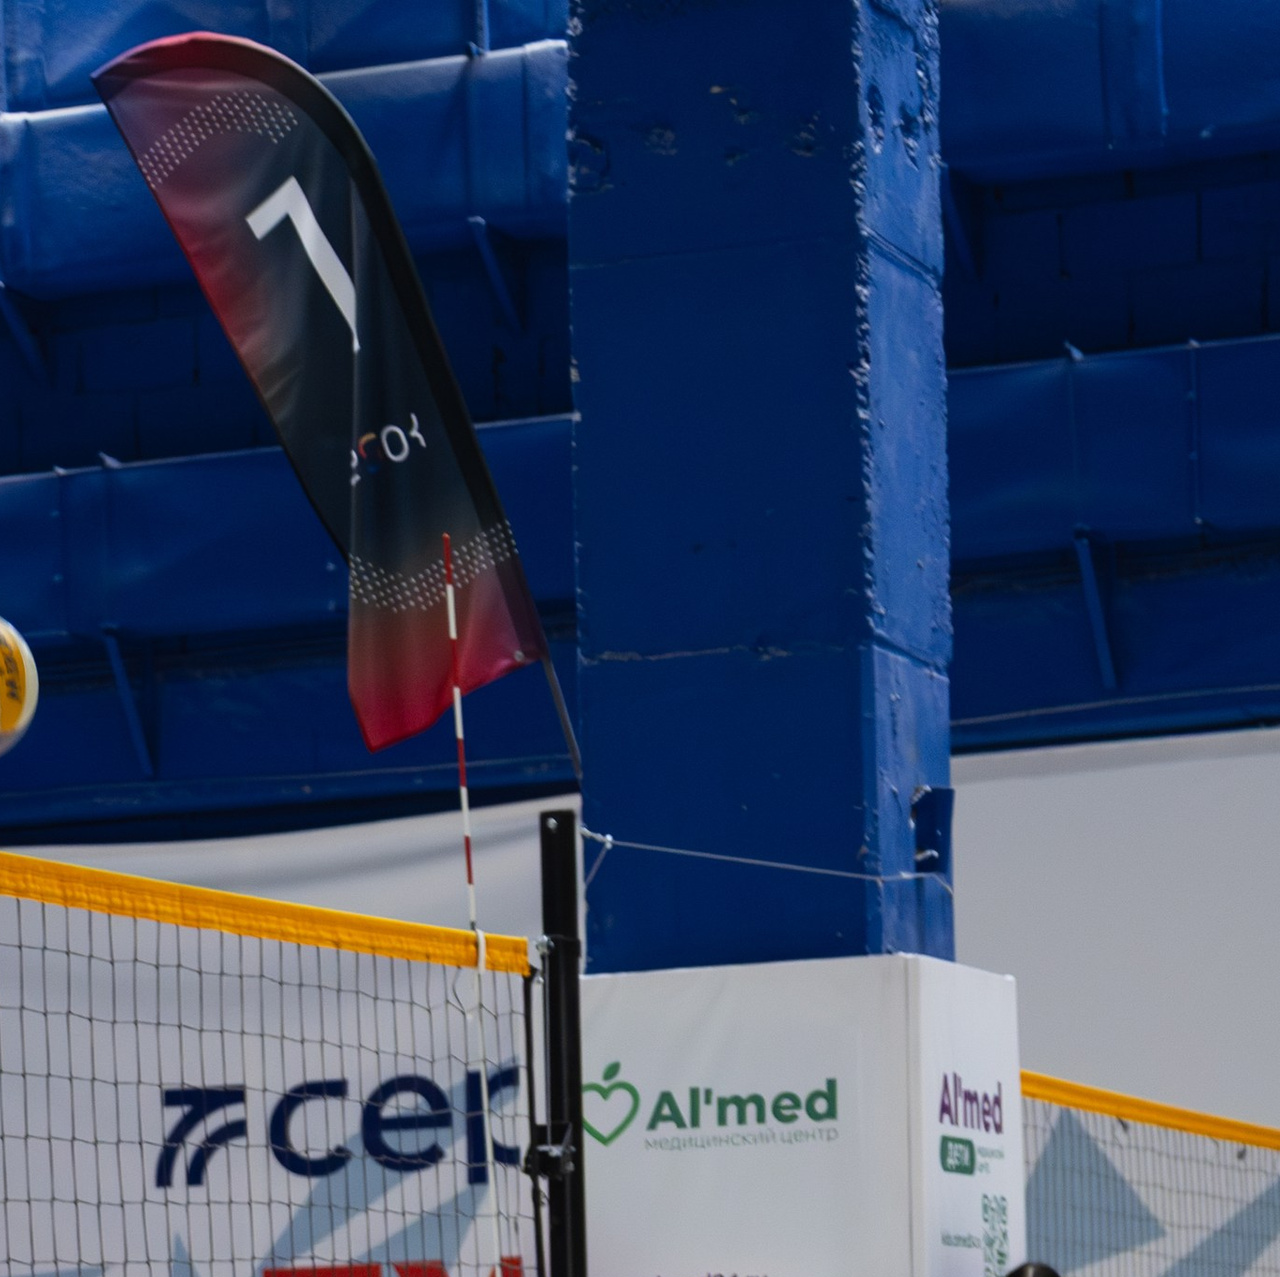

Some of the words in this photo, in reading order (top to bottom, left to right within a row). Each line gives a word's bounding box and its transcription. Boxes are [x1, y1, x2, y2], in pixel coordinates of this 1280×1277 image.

[646, 1078, 839, 1132] Al'med
[938, 1070, 1004, 1135] Al'med
[644, 1130, 777, 1151] медицинский
[780, 1127, 840, 1145] центр
